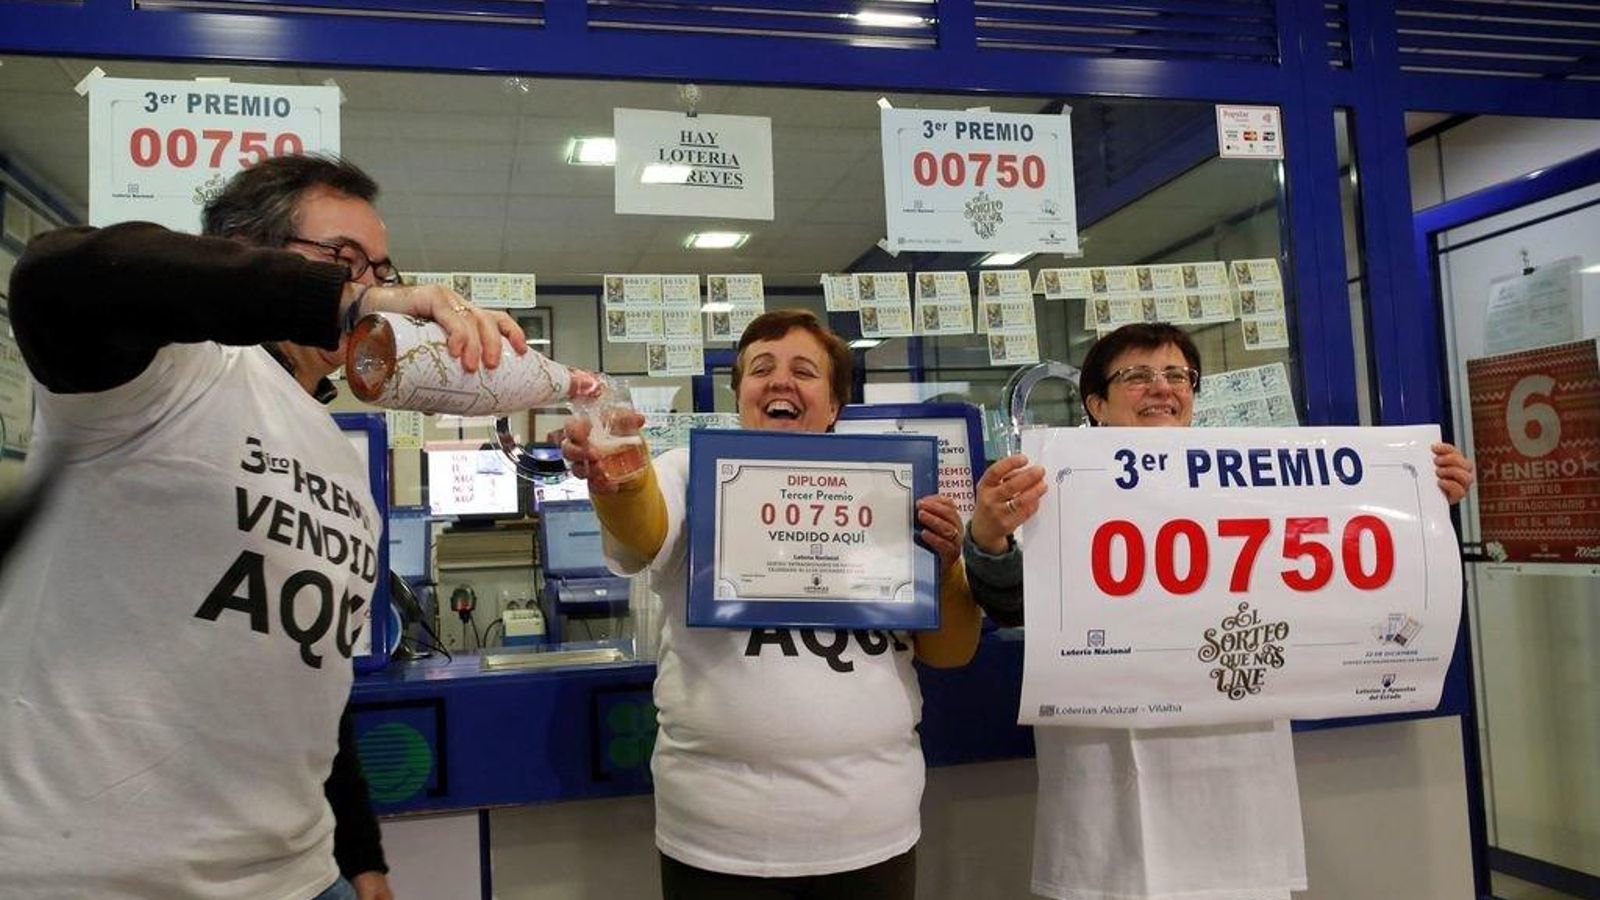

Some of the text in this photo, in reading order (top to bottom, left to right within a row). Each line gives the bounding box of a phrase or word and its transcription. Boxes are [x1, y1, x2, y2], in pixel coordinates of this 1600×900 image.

[144, 91, 292, 118] 3er PREMIO
[681, 130, 718, 145] HAY
[922, 120, 1034, 142] 3er PREMIO
[660, 149, 740, 166] LOTERIA
[687, 170, 743, 186] REYES
[913, 151, 1046, 189] 00750
[1508, 374, 1562, 458] 6
[937, 466, 971, 476] REMIO
[1113, 446, 1365, 490] 3er PREMIO
[1501, 459, 1579, 480] ENERO
[787, 475, 848, 487] DIPLOMA
[938, 479, 973, 488] REMIO
[780, 489, 854, 502] Tercer Premio
[235, 486, 378, 584] VENDID
[768, 530, 865, 545] VENDIDO AQUÍ
[1091, 514, 1395, 597] 00750
[194, 549, 366, 669] AQU
[1221, 601, 1261, 631] EL
[1093, 646, 1132, 656] Nacional
[1198, 621, 1290, 663] SORTEO
[1219, 644, 1285, 670] QUE NOS
[1209, 667, 1267, 701] UNE
